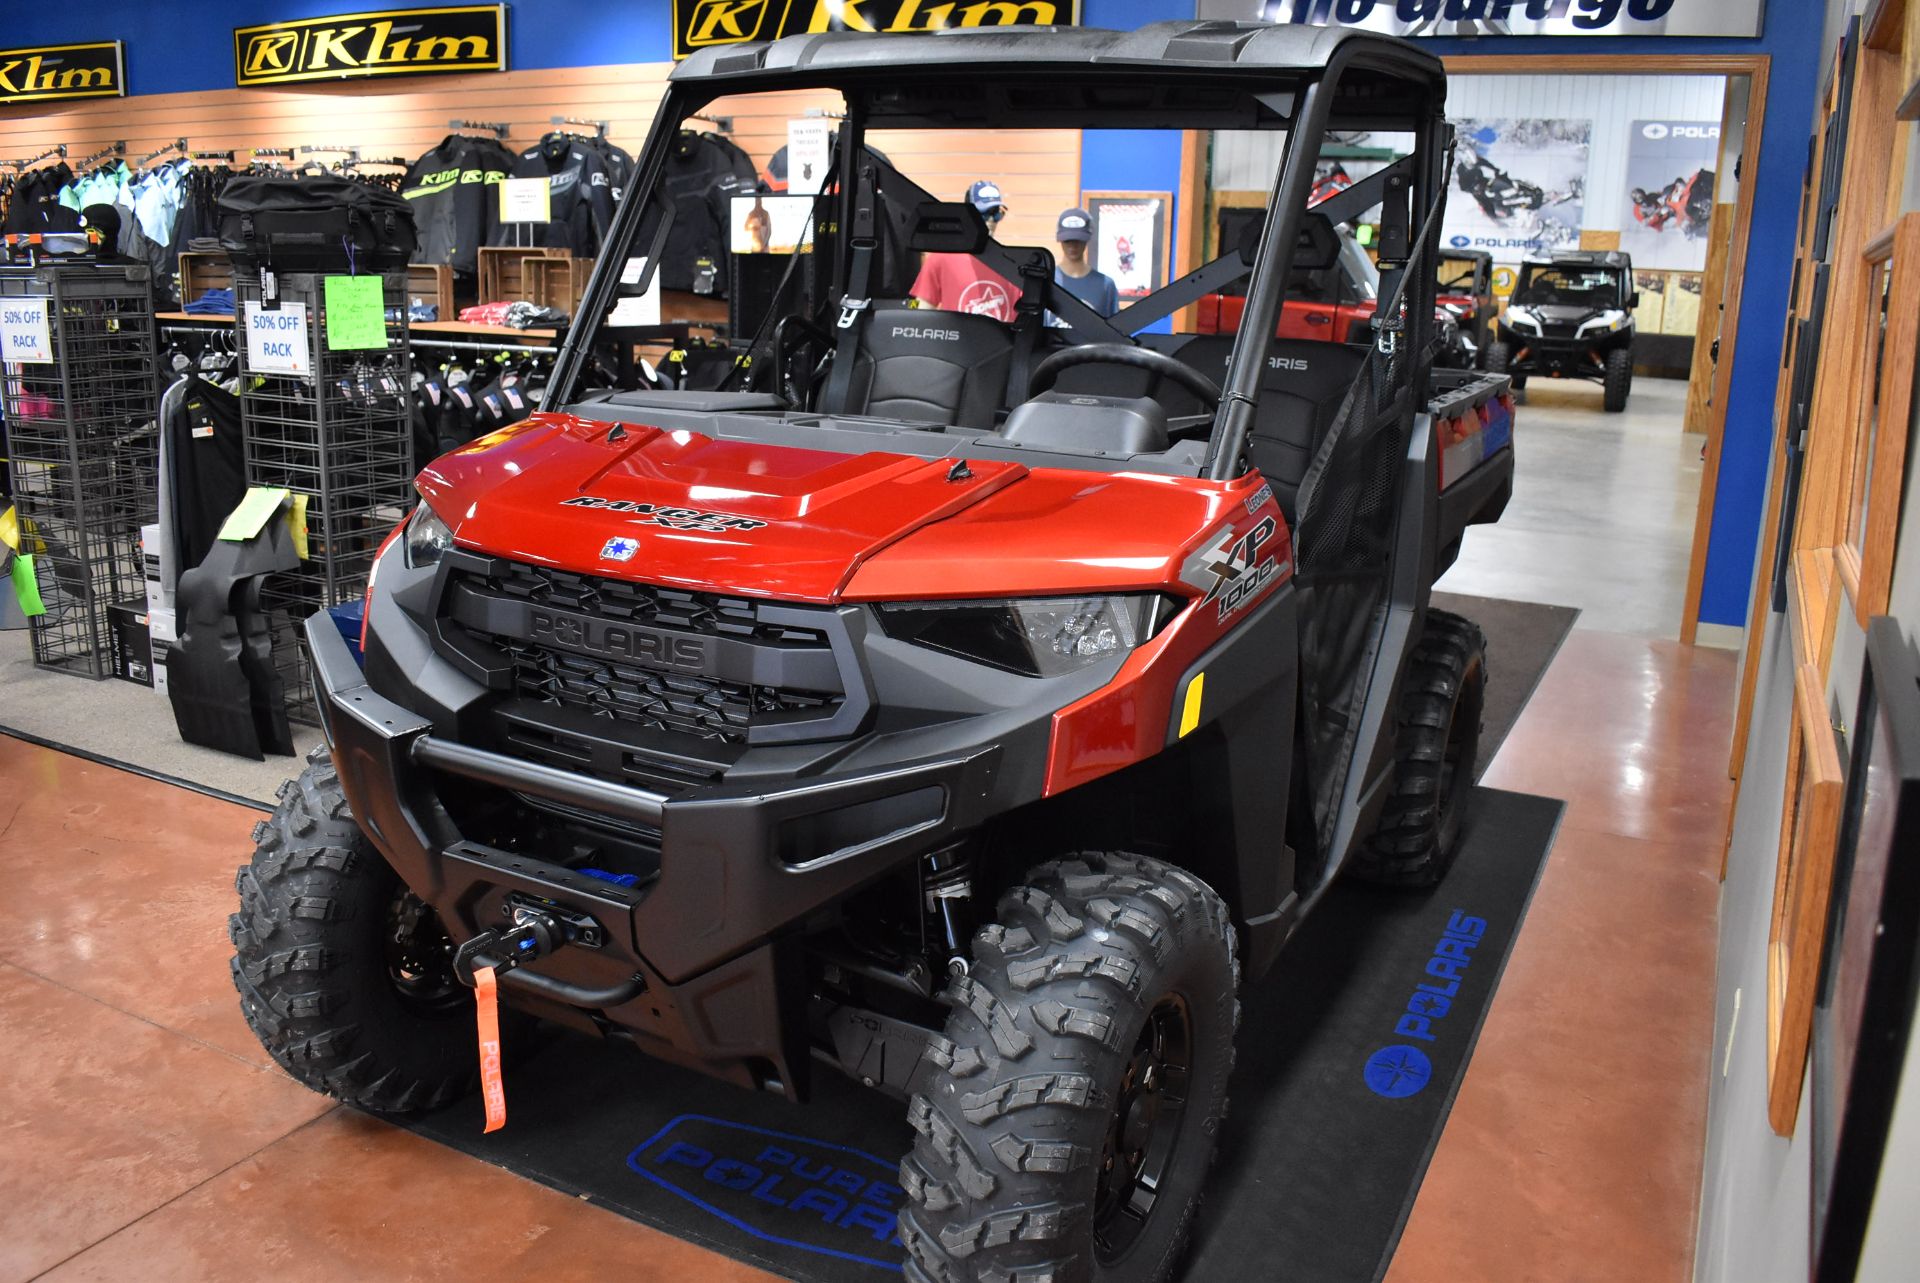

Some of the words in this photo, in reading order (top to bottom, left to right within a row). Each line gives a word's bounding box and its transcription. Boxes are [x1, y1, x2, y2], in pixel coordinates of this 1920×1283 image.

[308, 21, 490, 69] Klim
[4, 311, 22, 324] 50%
[23, 311, 42, 324] OFF
[253, 315, 276, 329] 50%
[278, 316, 299, 330] OFF
[892, 326, 960, 341] POLARIS
[12, 335, 37, 348] RACK
[263, 342, 293, 357] RACK
[1225, 355, 1308, 371] PARIS
[559, 496, 768, 531] RANGER
[624, 516, 727, 532] XP
[1197, 515, 1277, 613] XP
[1218, 554, 1275, 620] 1000
[112, 625, 122, 676] HELMET
[530, 610, 706, 670] POLARIS
[1394, 908, 1488, 1042] POLARIS
[655, 1142, 904, 1247] POLAR
[757, 1146, 908, 1206] PURE
